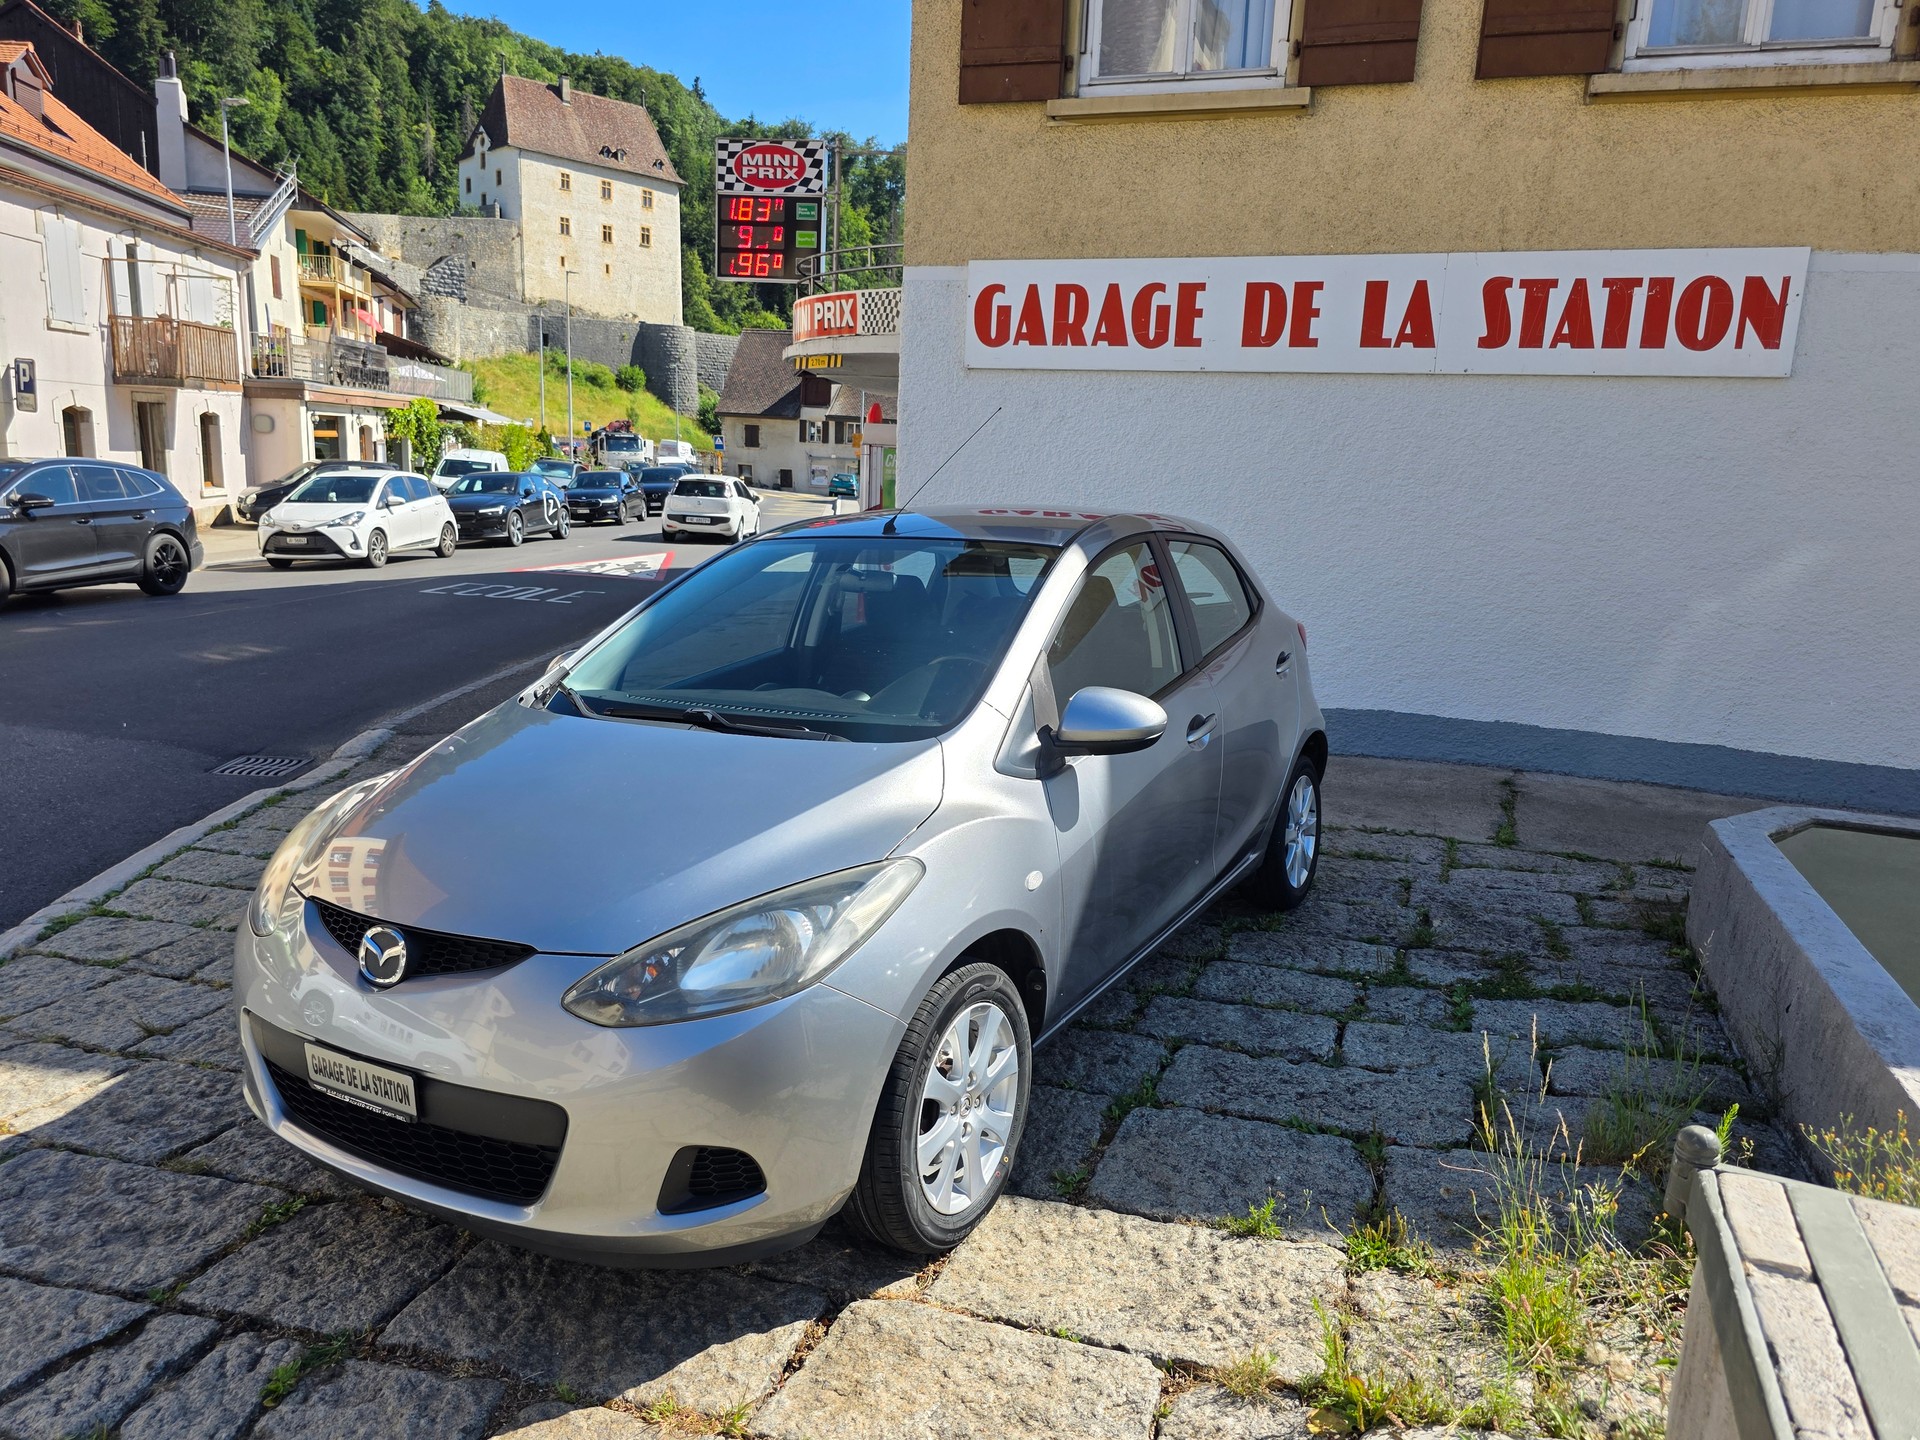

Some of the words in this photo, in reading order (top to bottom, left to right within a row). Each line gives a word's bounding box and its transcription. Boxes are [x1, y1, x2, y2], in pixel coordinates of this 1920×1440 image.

[742, 153, 799, 167] MINI
[742, 167, 799, 180] PRIX
[813, 298, 855, 331] PRIX
[973, 282, 1207, 349] GARAGE
[1241, 281, 1324, 348] DE
[1359, 279, 1436, 348] LA
[1477, 275, 1792, 352] STATION
[19, 362, 30, 391] P
[419, 582, 606, 604] ECOLE
[311, 1053, 346, 1084] GARAGE
[345, 1065, 359, 1089] DE
[358, 1069, 372, 1094] LA
[371, 1073, 411, 1107] STATION
